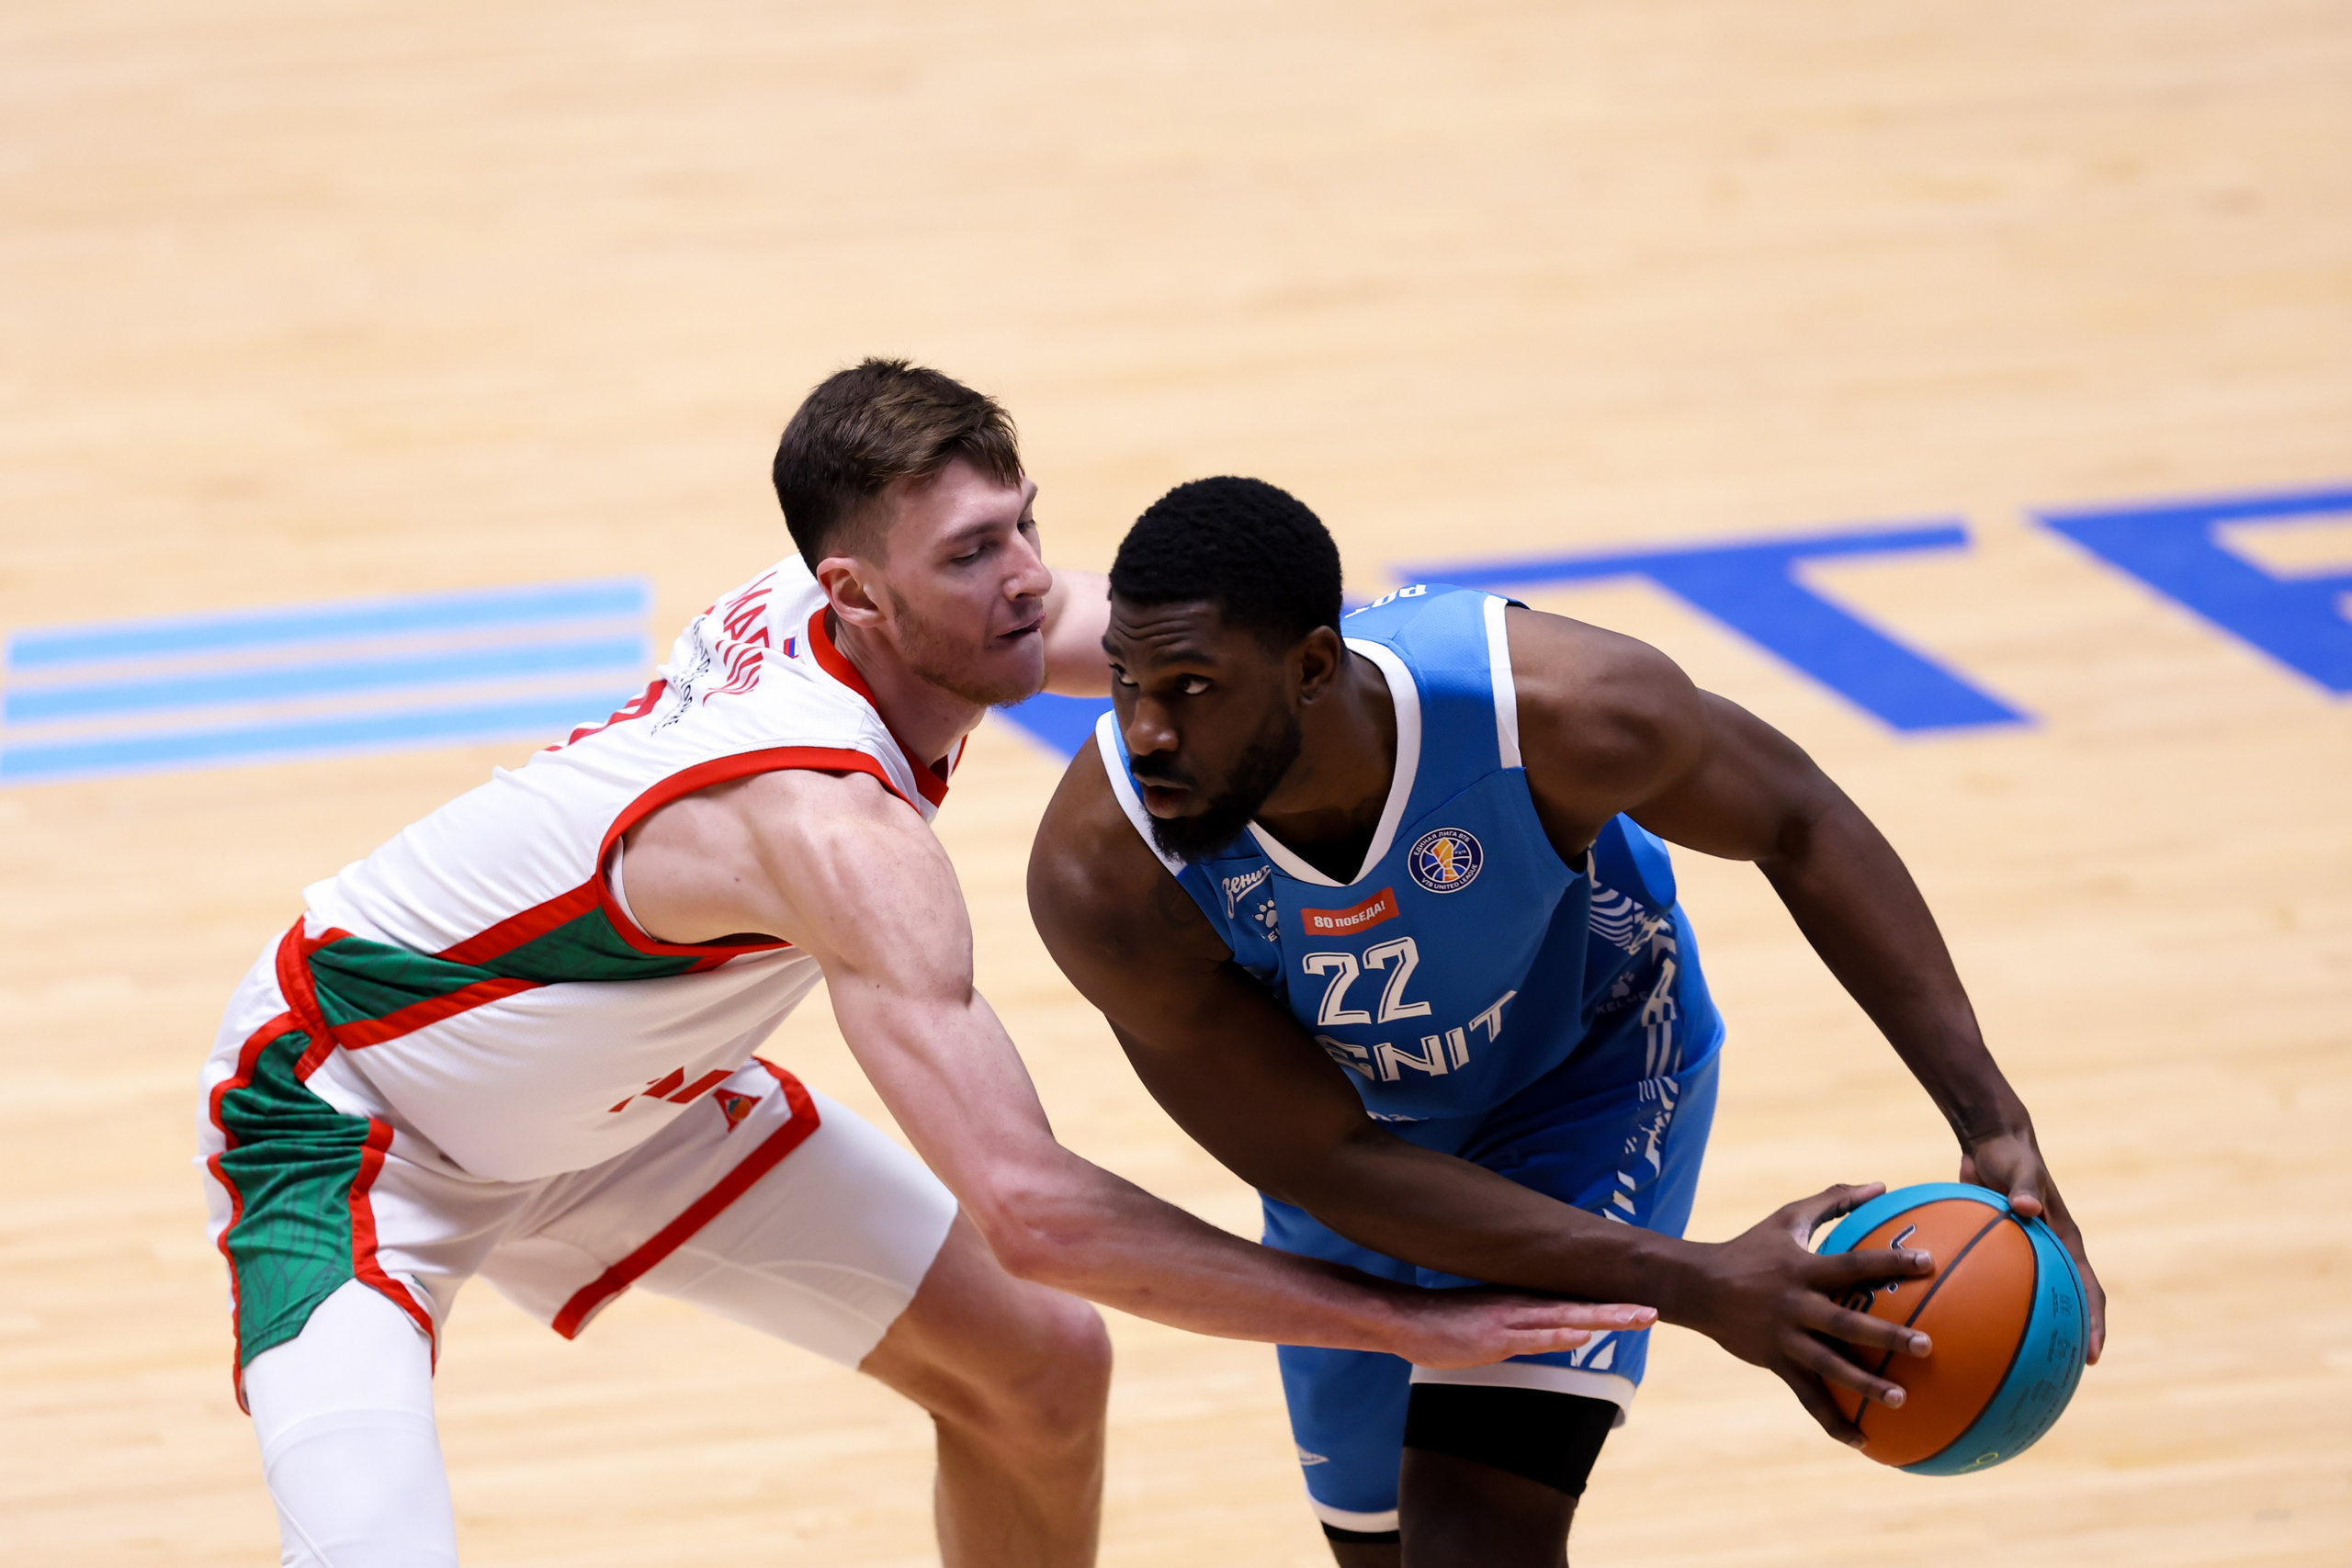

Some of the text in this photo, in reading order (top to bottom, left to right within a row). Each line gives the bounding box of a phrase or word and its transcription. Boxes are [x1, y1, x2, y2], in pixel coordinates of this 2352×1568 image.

[1413, 833, 1438, 856] ЕДИНАЯ
[1458, 832, 1471, 842] ВТБ
[1421, 863, 1478, 890] VTB UNITED LEAGUE
[1313, 899, 1386, 929] 80 ПОБЕДА!
[1302, 936, 1432, 1027] 22
[1314, 989, 1518, 1082] ENIT
